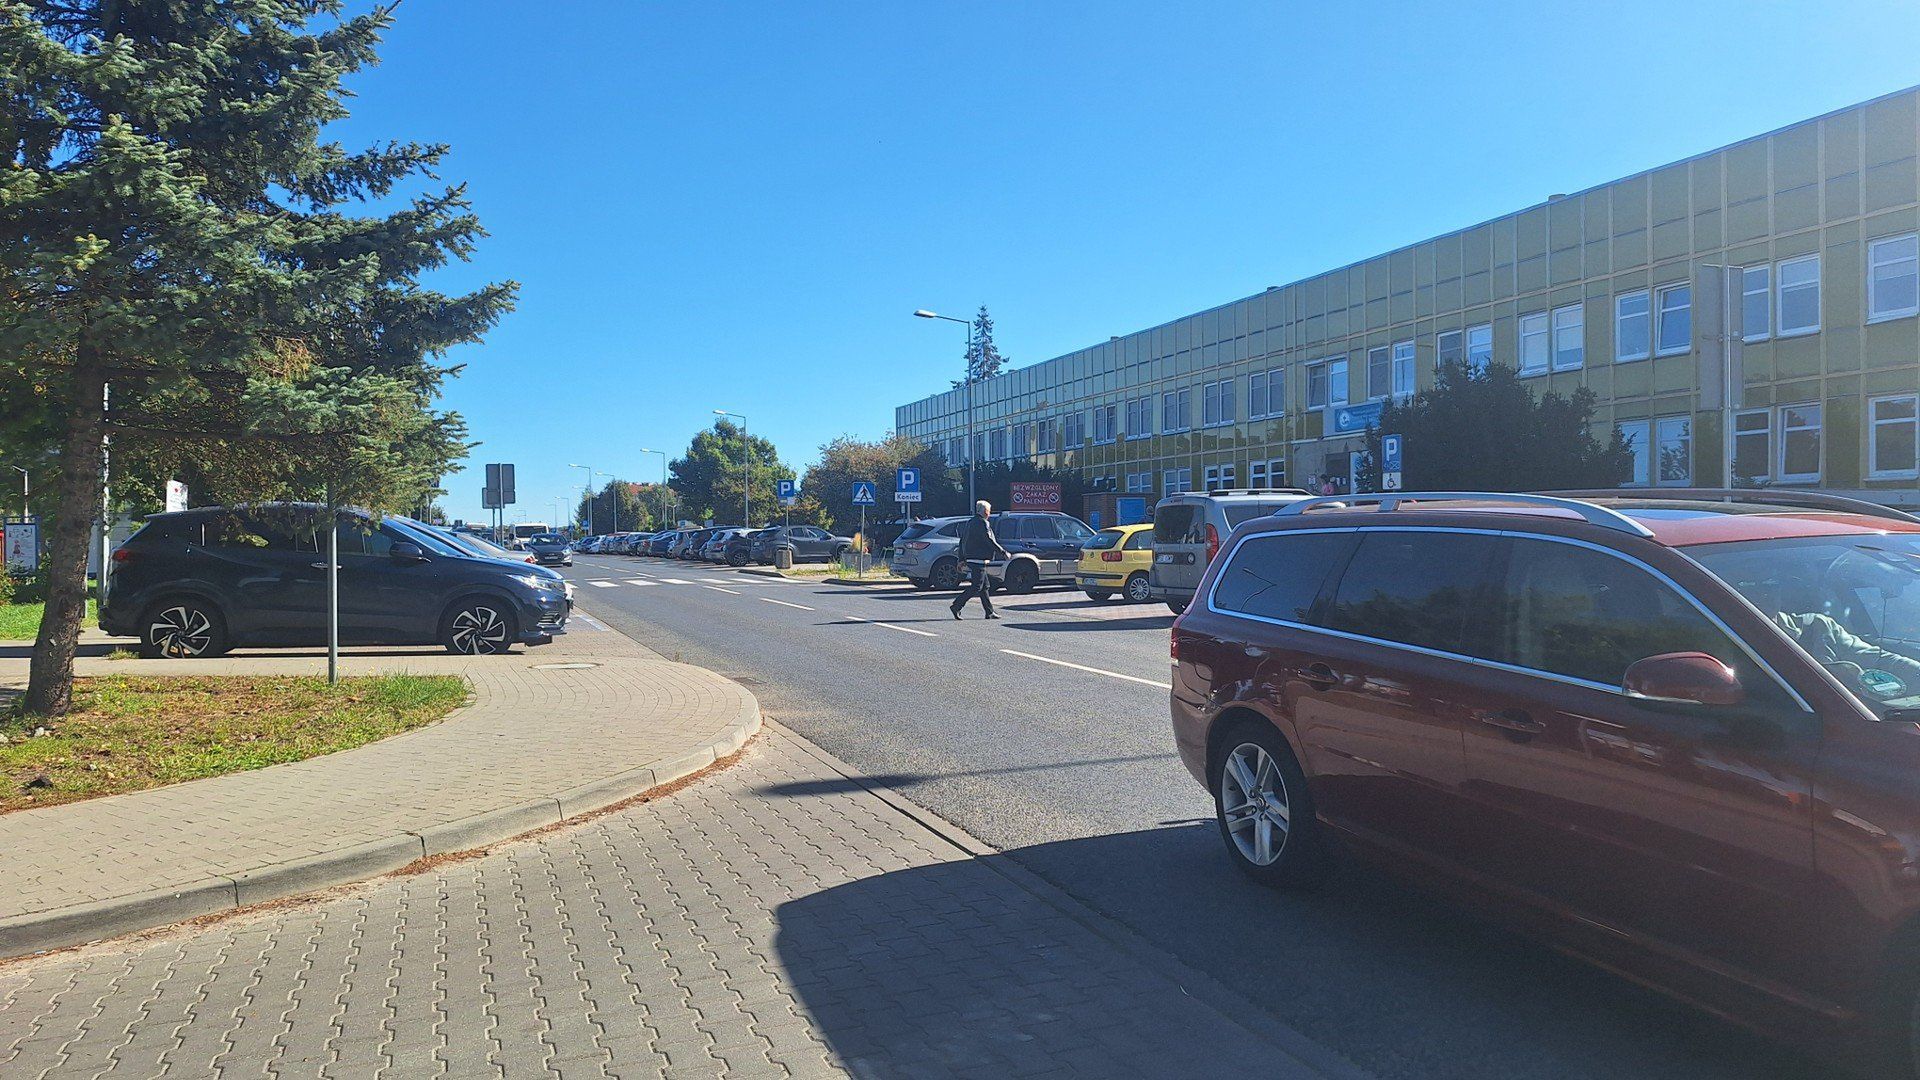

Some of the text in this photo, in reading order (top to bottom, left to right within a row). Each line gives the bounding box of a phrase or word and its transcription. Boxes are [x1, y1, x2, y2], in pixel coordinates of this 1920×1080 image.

[1386, 438, 1397, 461] P
[780, 481, 791, 494] P
[901, 471, 915, 489] P
[896, 493, 919, 501] Koniec
